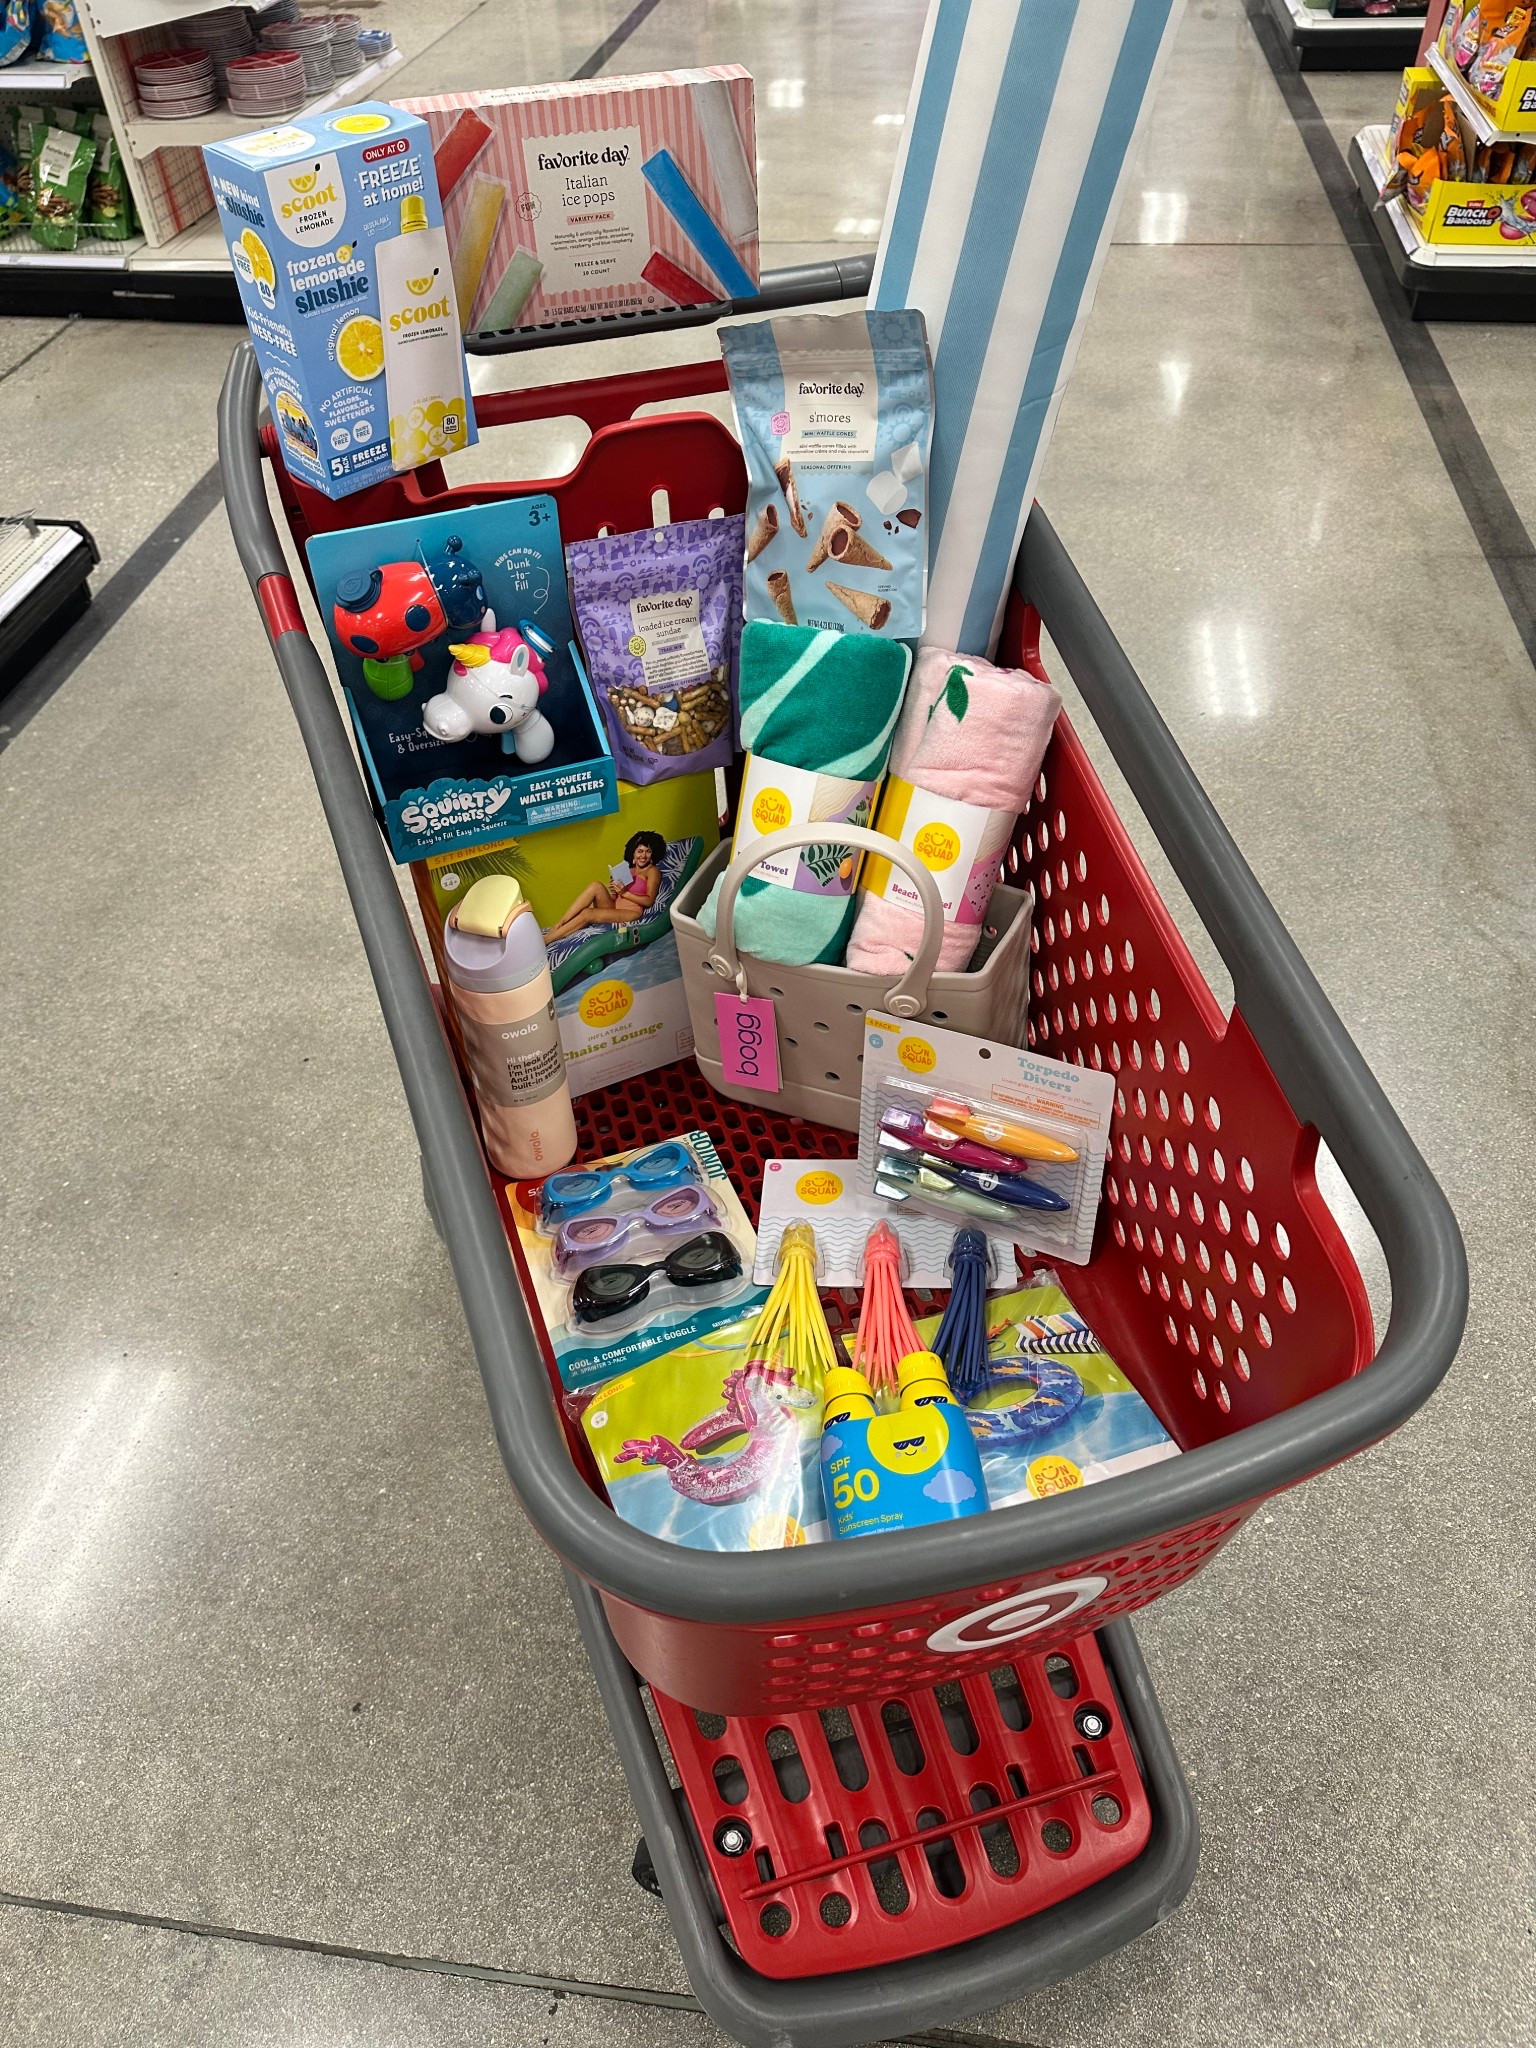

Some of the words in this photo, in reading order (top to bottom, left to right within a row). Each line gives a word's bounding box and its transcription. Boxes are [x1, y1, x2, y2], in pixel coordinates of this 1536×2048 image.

[366, 146, 386, 161] ONLY
[387, 144, 397, 155] AT
[538, 150, 599, 170] favorite
[601, 144, 629, 167] day
[358, 157, 421, 190] FREEZE
[566, 175, 608, 191] Italian
[213, 175, 220, 189] A
[219, 178, 241, 198] NEW
[240, 187, 260, 208] kind
[281, 182, 338, 219] scoot
[364, 191, 379, 207] at
[381, 175, 424, 202] home!
[562, 193, 580, 206] ice
[584, 191, 615, 207] pops
[217, 194, 227, 211] of
[226, 197, 265, 228] slushie
[299, 210, 327, 224] FROZEN
[570, 215, 594, 223] VARIETY
[295, 217, 334, 234] LEMONADE
[286, 251, 336, 277] frozen
[290, 259, 366, 292] lemonade
[295, 276, 369, 314] slushie
[389, 296, 451, 332] scoot
[250, 320, 298, 358] MESS-FREE
[327, 324, 339, 361] original
[336, 307, 360, 325] lemon
[402, 330, 420, 339] FROZEN
[320, 400, 332, 413] NO
[331, 385, 373, 402] ARTIFICIAL
[799, 383, 842, 395] favorite
[844, 383, 865, 398] day
[324, 405, 375, 428] SWEETENERS
[446, 416, 456, 425] 80
[809, 411, 851, 423] s'mores
[334, 437, 349, 446] FREE
[356, 429, 370, 438] FREE
[352, 443, 387, 463] FREEZE
[331, 458, 344, 476] 5
[343, 456, 351, 472] PACK
[529, 510, 551, 526] 3+
[494, 553, 508, 567] KIDS
[508, 548, 522, 556] CAN
[523, 547, 533, 555] DO
[532, 550, 542, 560] IT!
[506, 557, 531, 571] Dunk
[510, 571, 531, 580] -to-
[515, 580, 529, 591] Fill
[636, 600, 674, 614] favorite
[675, 597, 693, 609] day
[638, 621, 662, 633] loaded
[663, 619, 674, 628] ice
[675, 616, 697, 625] cream
[656, 627, 682, 638] sundae
[388, 727, 429, 743] Easy-Sq
[397, 743, 406, 754] &
[530, 771, 592, 792] EASY-SQUEEZE
[520, 790, 553, 806] WATER
[557, 779, 605, 797] BLASTERS
[543, 800, 581, 813] WARNING:
[760, 798, 785, 814] SUN
[755, 808, 786, 826] SQUAD
[417, 838, 434, 846] Easy
[481, 821, 507, 831] Squeeze
[924, 832, 953, 850] SUN
[434, 857, 441, 865] 5
[442, 854, 454, 862] FT
[465, 847, 476, 855] IN
[478, 840, 505, 852] LONG
[917, 842, 953, 861] SQUAD
[760, 860, 789, 876] Towel
[892, 883, 919, 900] Beach
[588, 989, 623, 1008] SUN
[586, 998, 629, 1019] SQUAD
[501, 1022, 539, 1040] owala
[588, 1022, 633, 1042] INFLATABLE
[611, 1021, 664, 1046] Lounge
[875, 1021, 892, 1030] PACK
[736, 1012, 763, 1077] bogg
[905, 1044, 930, 1056] SUN
[506, 1056, 516, 1064] Hi
[507, 1063, 522, 1071] I'm
[523, 1056, 541, 1069] leak
[509, 1070, 523, 1078] I'm
[524, 1051, 558, 1074] insulated
[902, 1051, 932, 1066] SQUAD
[510, 1076, 528, 1084] And
[535, 1065, 552, 1077] have
[511, 1077, 543, 1091] built-in
[544, 1063, 561, 1080] straw
[1017, 1057, 1080, 1082] Torpedo
[1022, 1070, 1072, 1093] Divers
[529, 1128, 543, 1162] owala
[689, 1131, 728, 1181] JUNIOR
[801, 1187, 838, 1196] SQUAD
[805, 1179, 834, 1187] SUN
[568, 1358, 592, 1372] COOL
[593, 1355, 601, 1364] &
[601, 1335, 663, 1360] COMFORTABLE
[664, 1325, 698, 1341] GOGGLE
[581, 1361, 607, 1374] SPRINTER
[607, 1355, 628, 1366] 3-PACK
[595, 1396, 602, 1404] IN
[603, 1383, 625, 1397] LONG
[830, 1456, 851, 1475] SPF
[1035, 1464, 1069, 1485] SUN
[833, 1468, 880, 1509] 50
[1037, 1474, 1078, 1497] SQUAD
[838, 1511, 854, 1525] Kids'
[839, 1517, 880, 1535] Sunscreen
[880, 1512, 904, 1525] Spray
